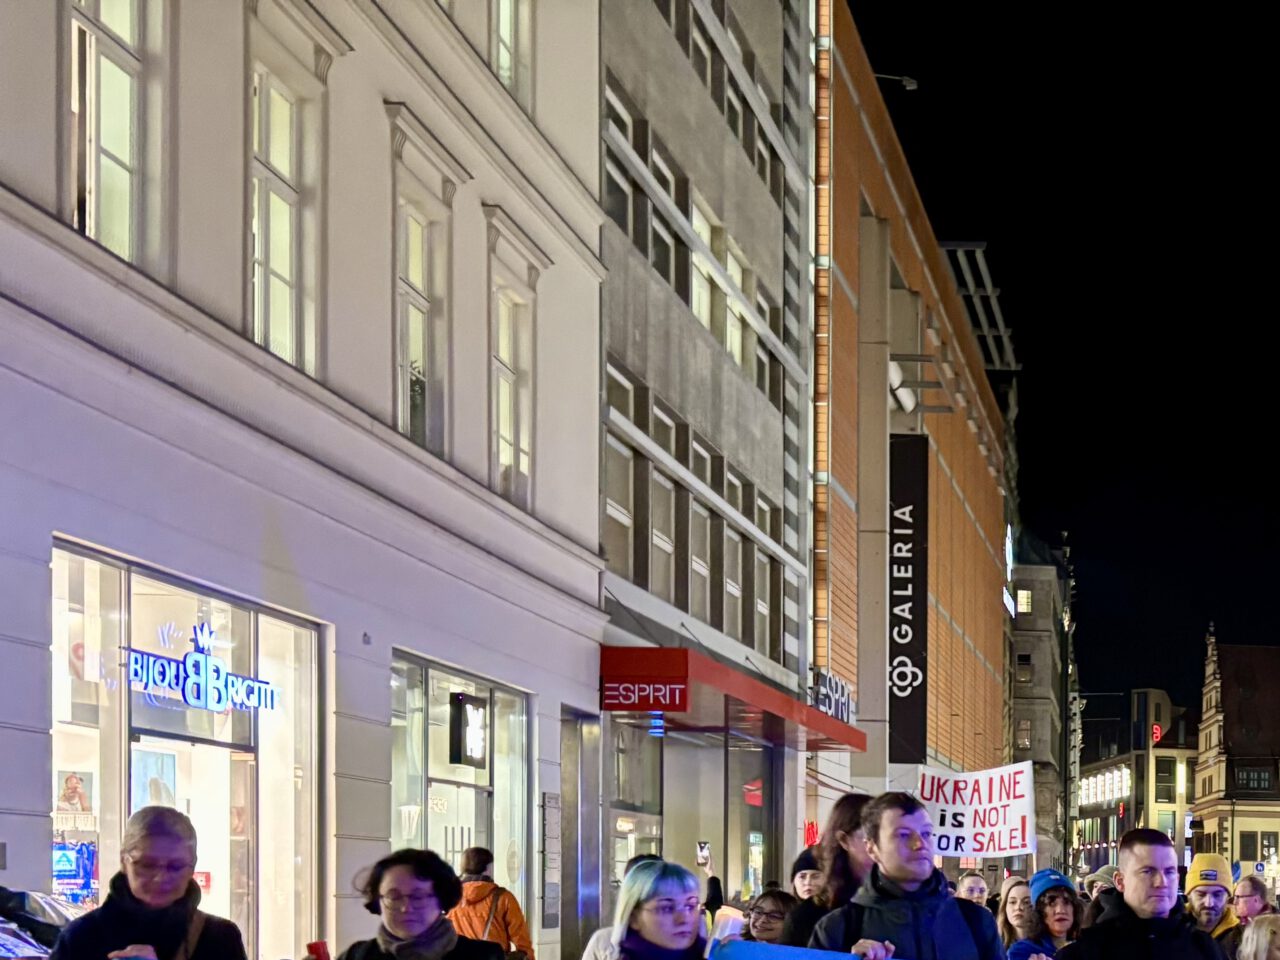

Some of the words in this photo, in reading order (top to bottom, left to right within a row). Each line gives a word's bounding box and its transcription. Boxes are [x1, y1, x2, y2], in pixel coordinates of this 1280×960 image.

[892, 504, 914, 644] GALERIA
[604, 683, 686, 705] ESPRIT
[920, 769, 1026, 806] UKRAINE
[932, 832, 966, 853] OR
[972, 815, 1028, 853] SALE!
[972, 803, 1011, 829] NOT
